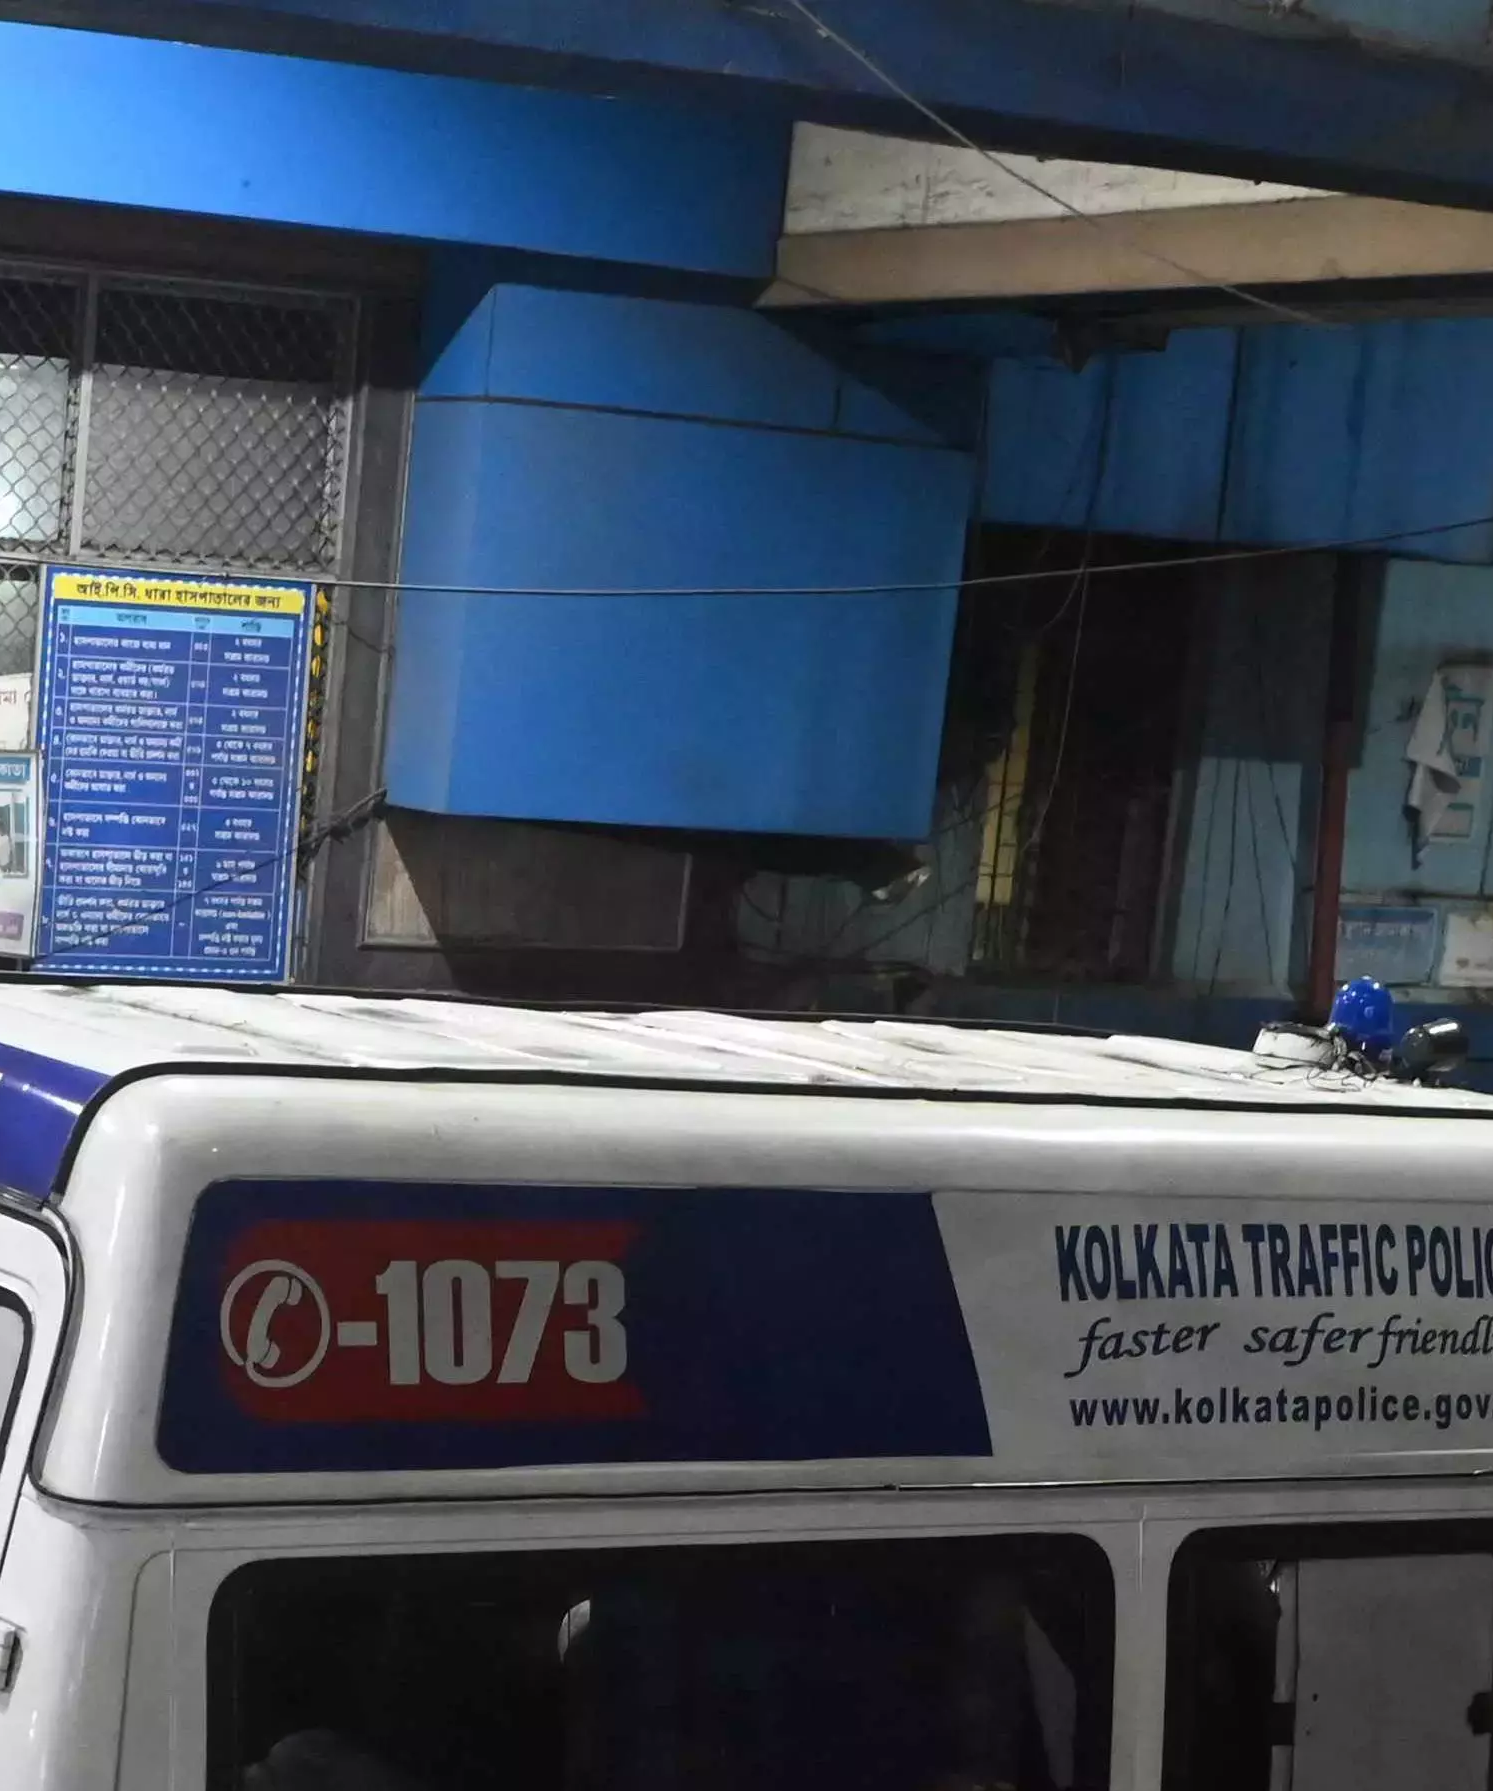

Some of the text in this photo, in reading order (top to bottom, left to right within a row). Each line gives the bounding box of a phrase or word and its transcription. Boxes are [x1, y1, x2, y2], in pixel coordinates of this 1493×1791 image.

[1054, 1224, 1240, 1303] KOLKATA
[1241, 1224, 1400, 1301] TRAFFIC
[1062, 1314, 1222, 1380] faster
[1243, 1312, 1376, 1370] safer
